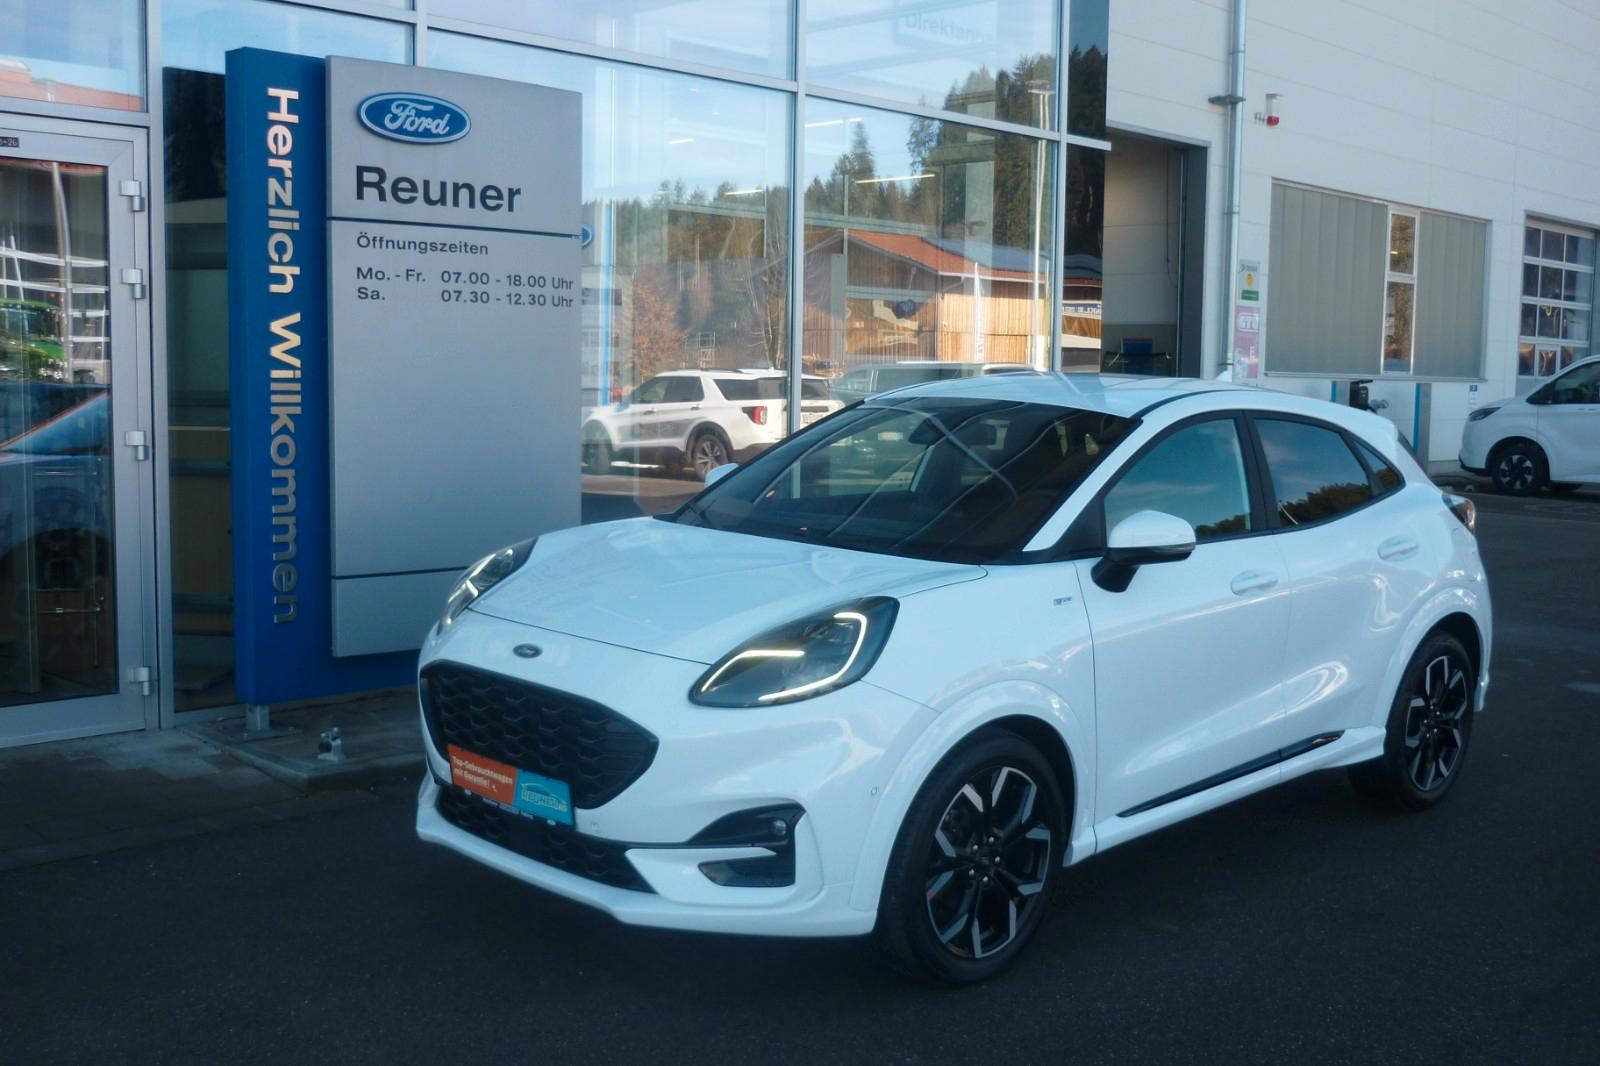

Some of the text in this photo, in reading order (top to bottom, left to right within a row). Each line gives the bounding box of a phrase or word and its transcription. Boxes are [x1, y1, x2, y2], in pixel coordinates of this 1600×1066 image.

[383, 100, 451, 135] Ford
[356, 164, 522, 214] Reuner
[356, 231, 489, 255] Öffnungszeiten
[356, 266, 391, 281] Mo.
[405, 268, 427, 282] Fr.
[440, 270, 490, 285] 07.00
[505, 274, 547, 289] 18.00
[551, 276, 575, 290] Uhr
[357, 286, 386, 301] Sa.
[440, 289, 490, 304] 07.30
[505, 293, 547, 307] 12.30
[551, 295, 575, 308] Uhr
[266, 87, 302, 624] Herzlich Willkommen
